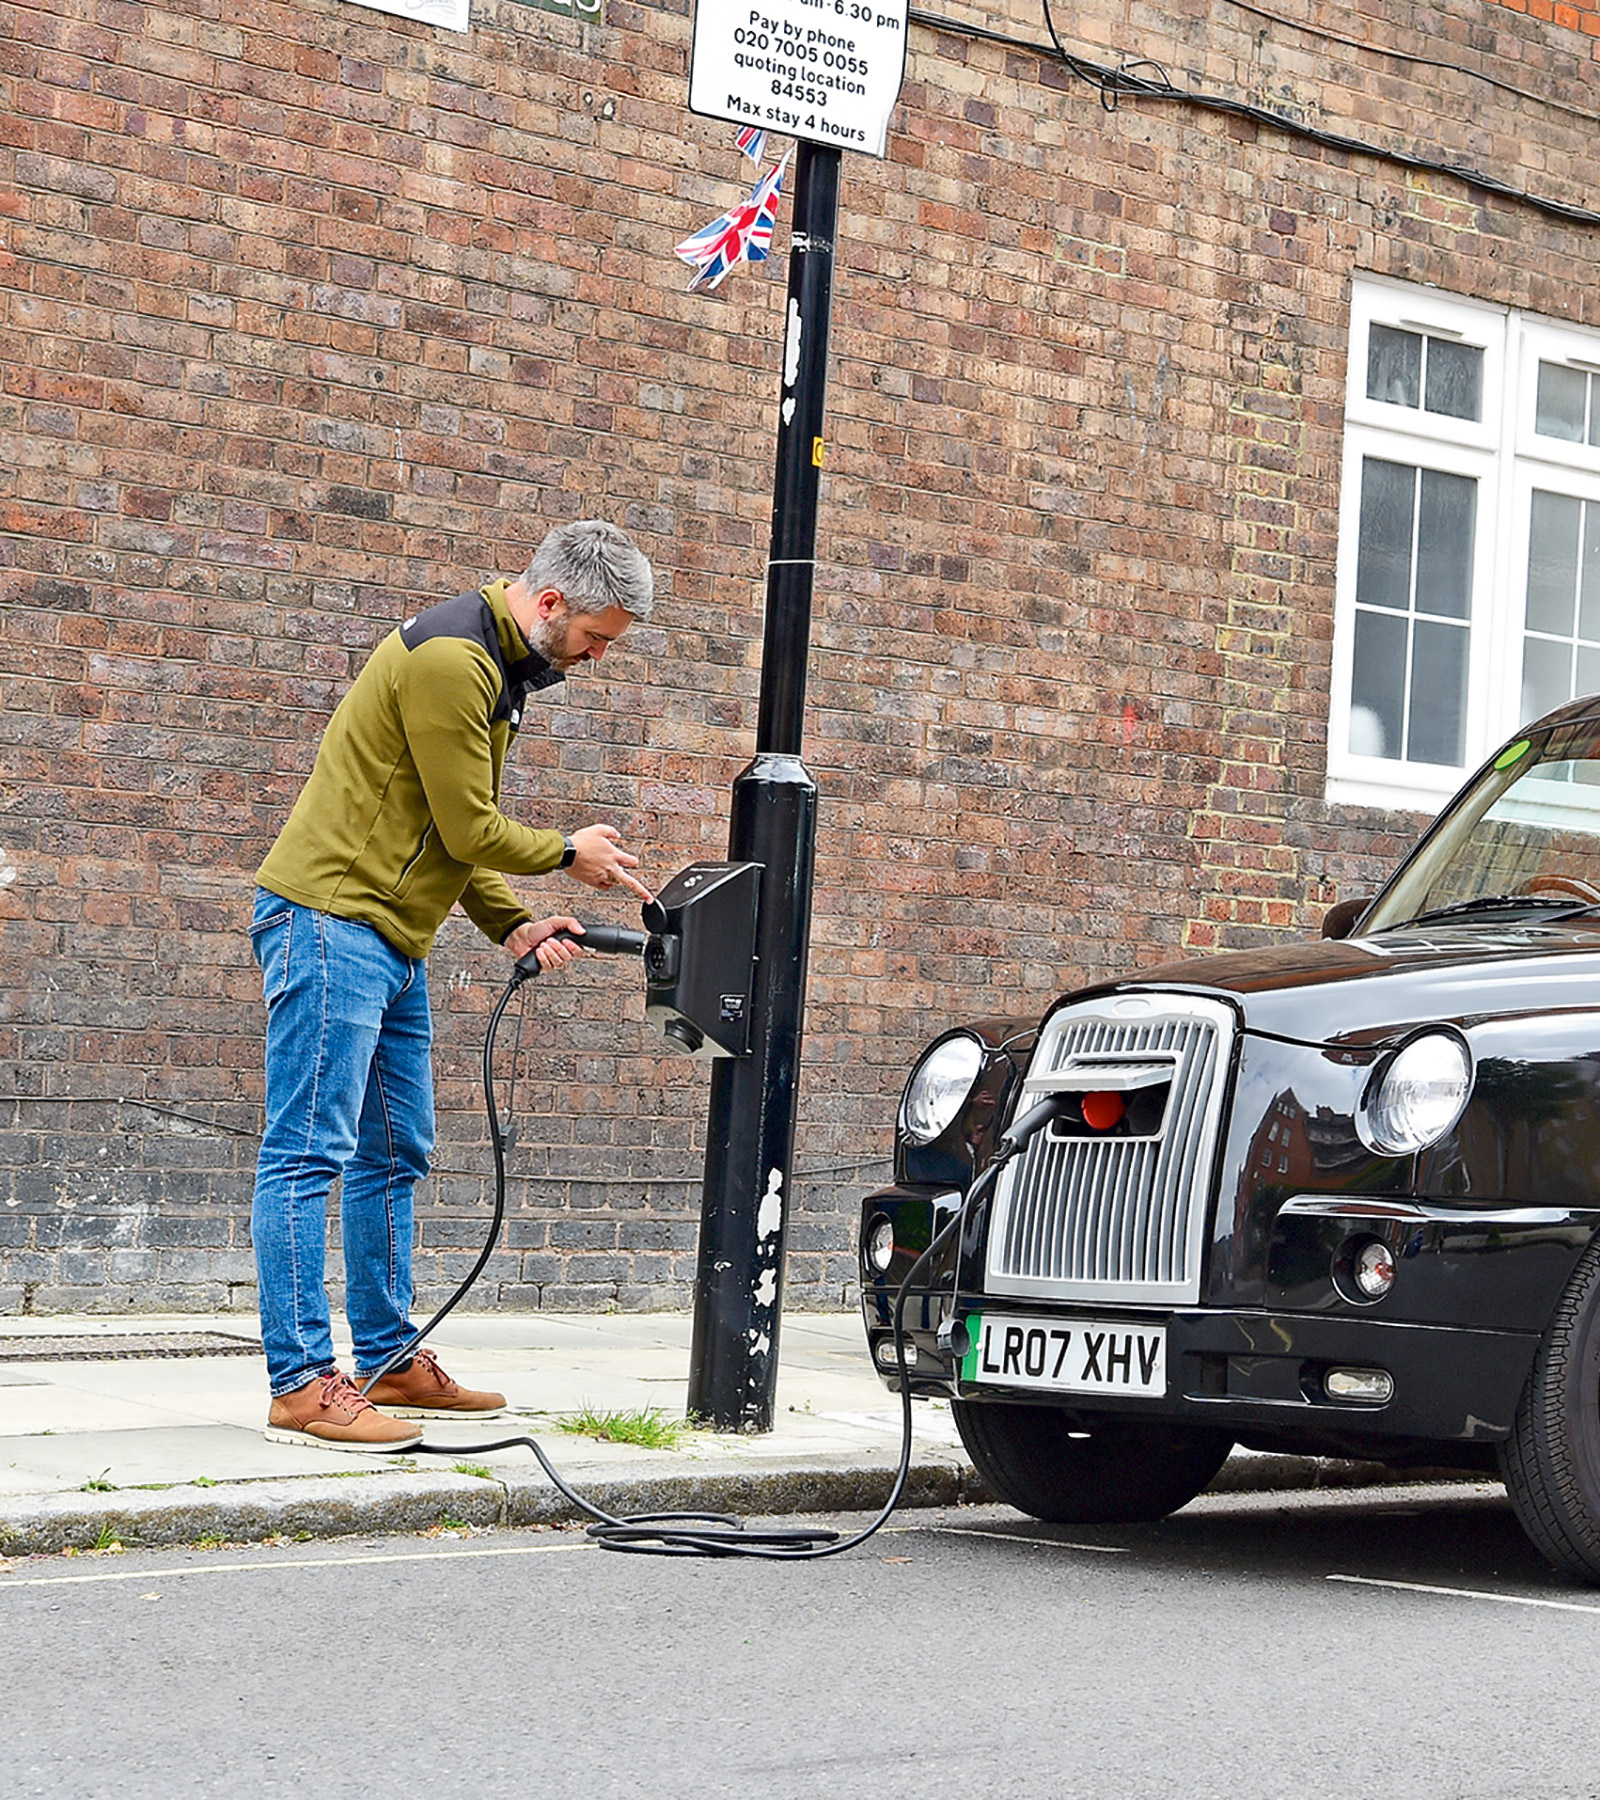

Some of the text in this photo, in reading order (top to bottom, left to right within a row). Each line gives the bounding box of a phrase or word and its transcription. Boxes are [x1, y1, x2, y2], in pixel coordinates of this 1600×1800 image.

[749, 10, 856, 53] Pay by phone
[834, 0, 872, 22] 6.30
[876, 14, 900, 30] pm
[734, 27, 869, 76] 020 7005 0055
[733, 52, 866, 96] quoting location
[770, 79, 828, 107] 84553
[727, 94, 866, 142] Max stay 4 hours
[982, 1324, 1162, 1386] LR07 XHV
